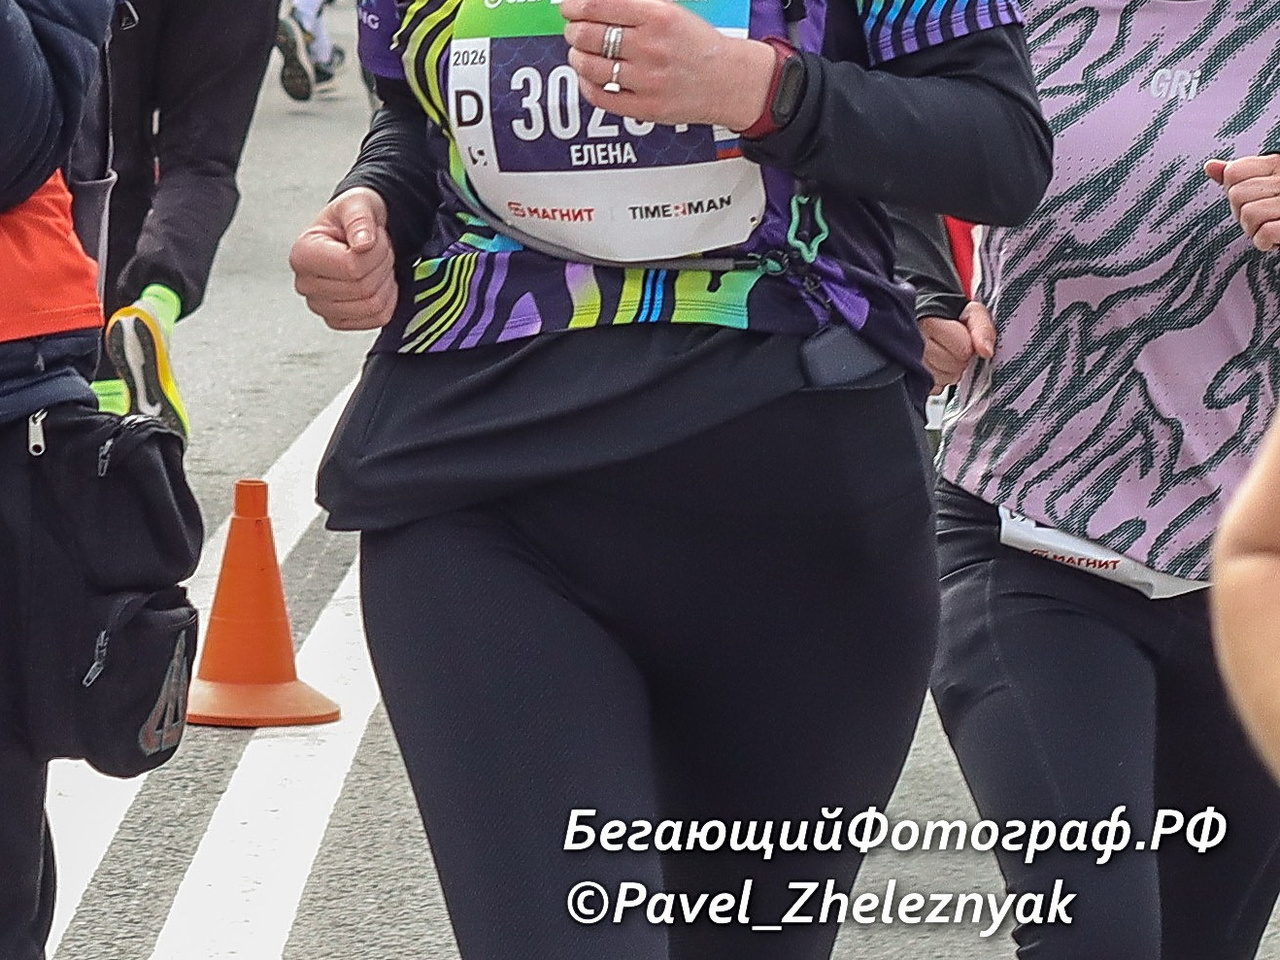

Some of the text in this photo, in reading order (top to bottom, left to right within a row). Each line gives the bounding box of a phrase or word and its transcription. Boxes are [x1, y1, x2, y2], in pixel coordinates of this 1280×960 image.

[452, 49, 486, 66] 2026
[455, 90, 484, 128] D
[570, 141, 638, 166] ЕЛЕНА
[527, 207, 595, 222] МАГНИТ
